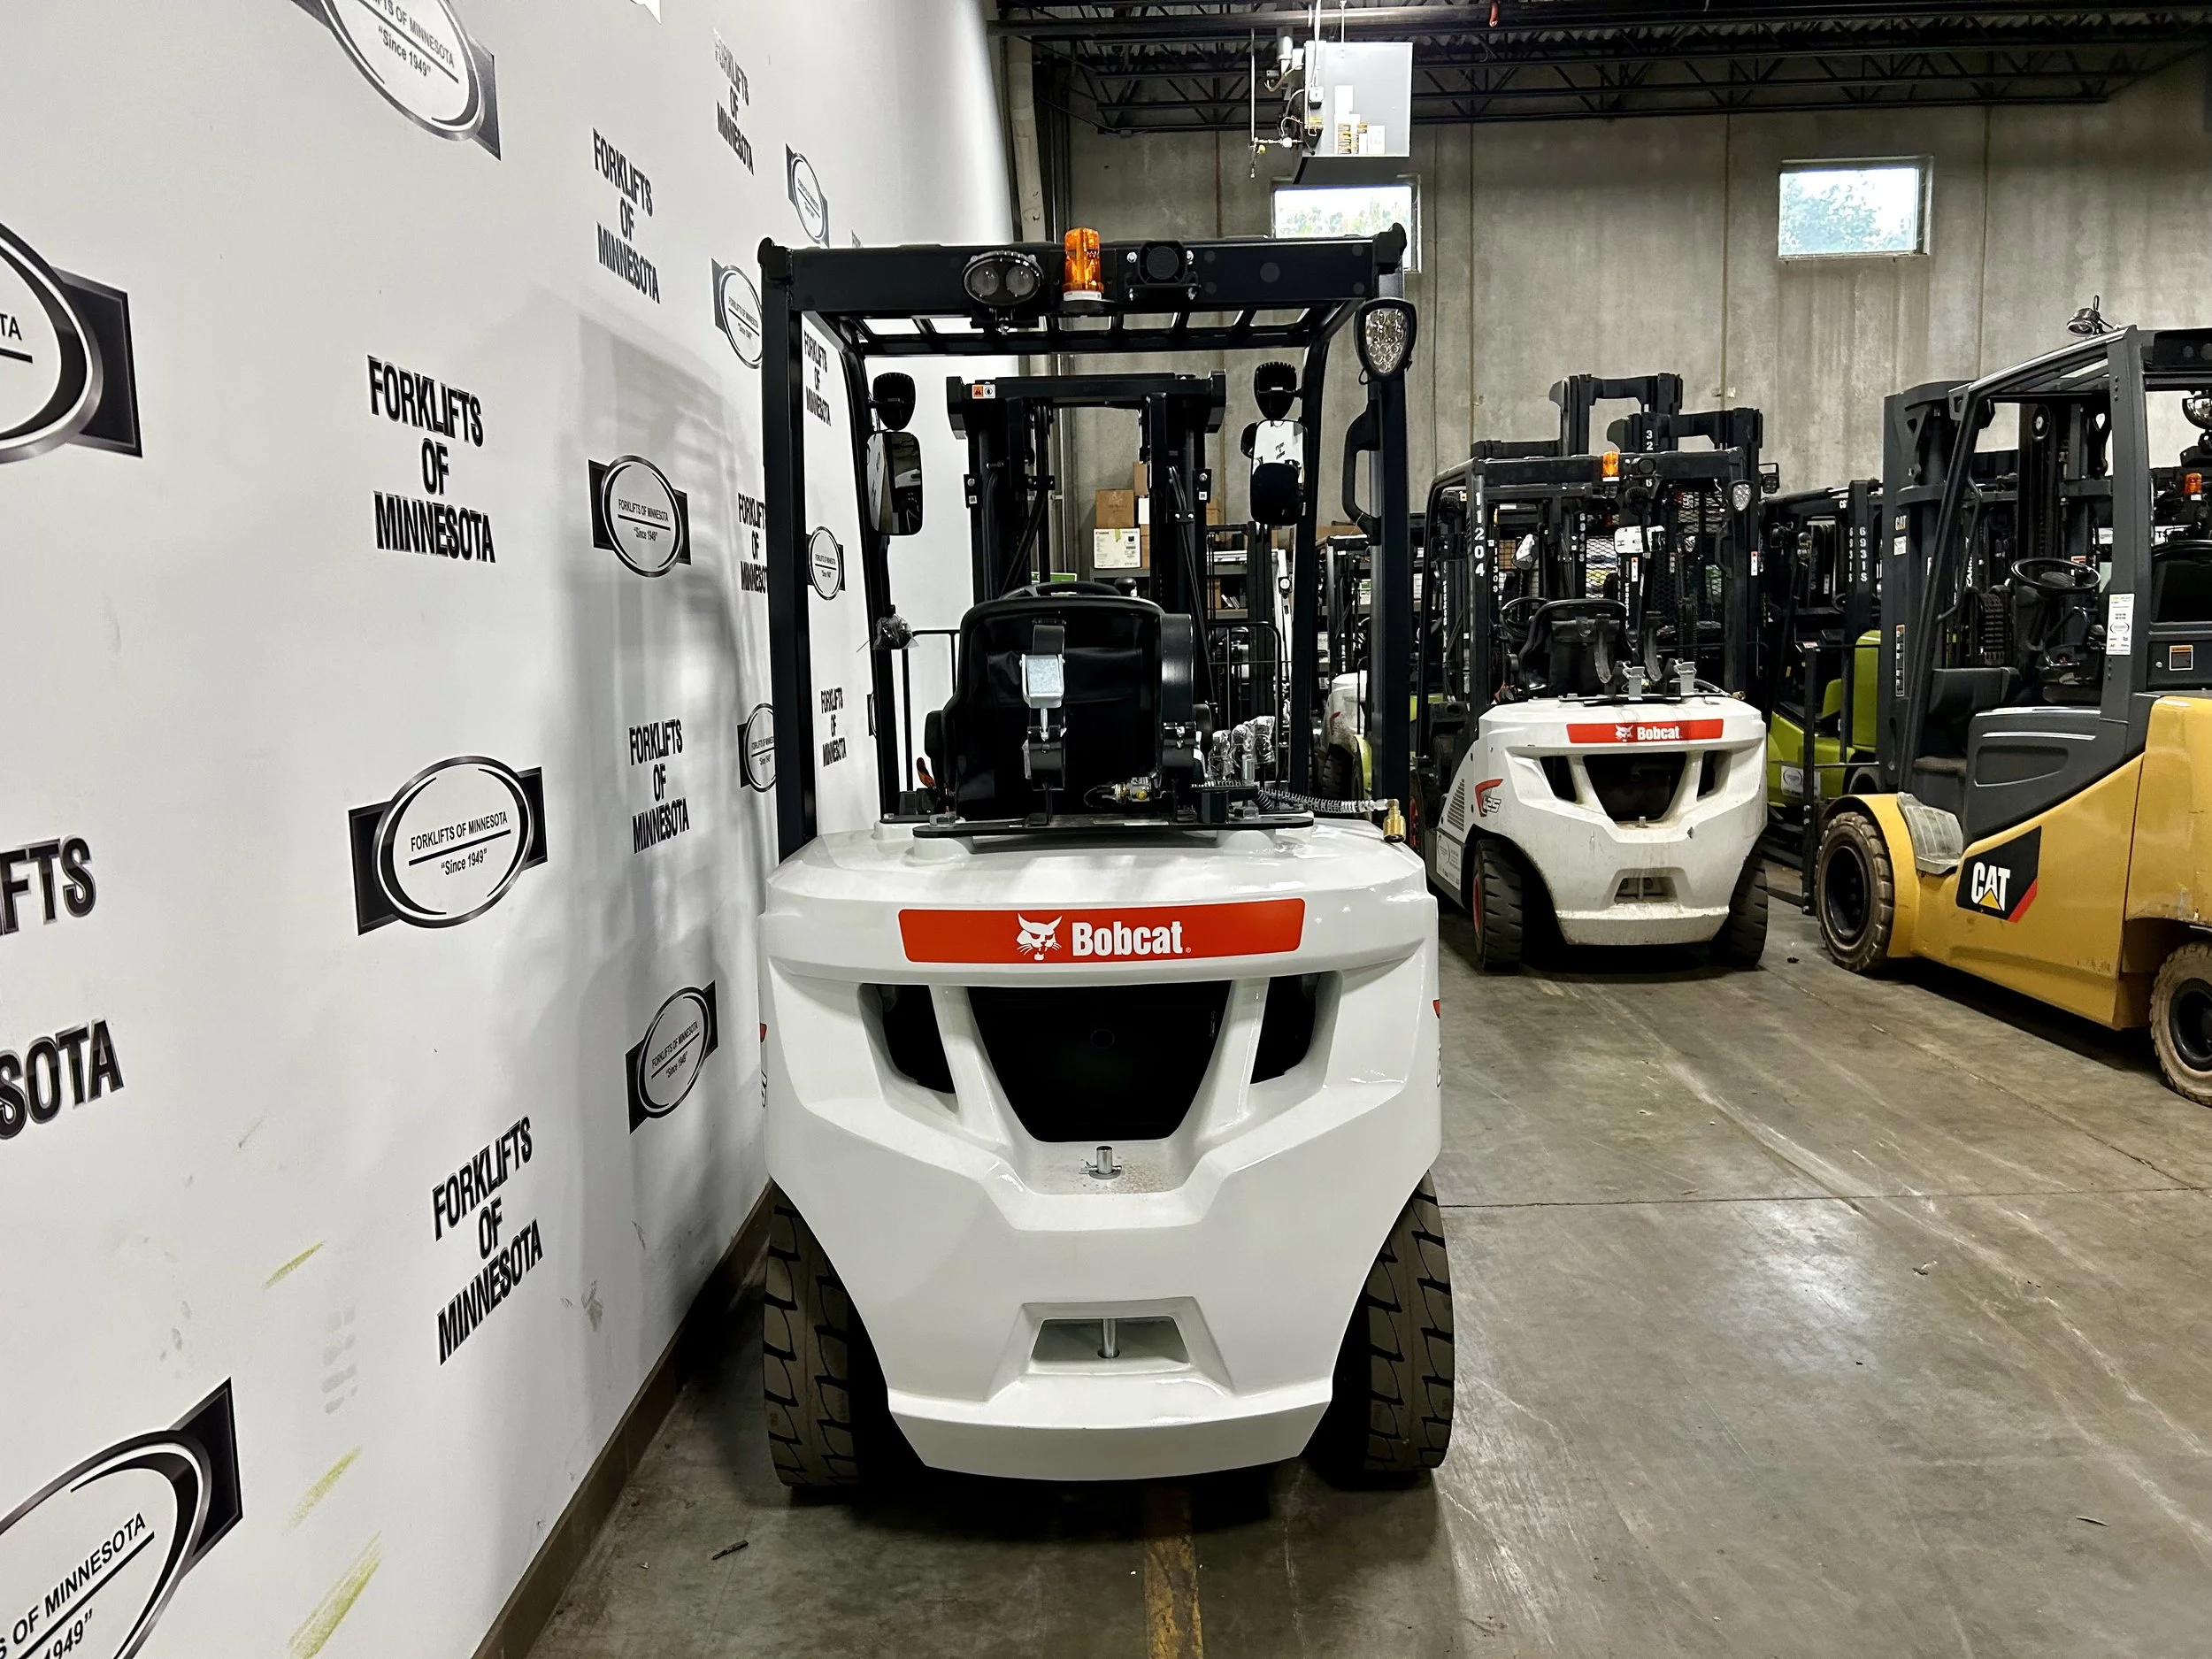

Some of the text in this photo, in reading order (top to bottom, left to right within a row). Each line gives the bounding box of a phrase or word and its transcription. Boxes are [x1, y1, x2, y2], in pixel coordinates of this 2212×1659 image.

[379, 26, 431, 76] “Since 1949”
[396, 6, 407, 26] OF
[410, 17, 455, 68] MINNESOTA
[714, 37, 749, 106] FORKLIFTS
[729, 85, 739, 121] OF
[716, 99, 754, 176] MINNESOTA
[593, 127, 653, 218] FORKLIFTS
[619, 196, 634, 242] OF
[596, 221, 661, 304] MINNESOTA
[803, 329, 827, 373] FORKLIFTS
[367, 355, 484, 448] FORKLIFTS
[814, 366, 820, 392] OF
[805, 385, 832, 426] MINNESOTA
[421, 437, 449, 495] OF
[373, 490, 495, 563] MINNESOTA
[618, 499, 669, 522] FORKLIFTS OF MINNESOTA
[738, 492, 766, 530] FORKLIFT
[751, 531, 759, 560] OF
[629, 718, 683, 765] FORKLIFTS
[1637, 726, 1680, 740] Bobcat
[653, 764, 666, 802] OF
[411, 811, 508, 851] FORKLIFTS OF MINNESOTA
[632, 796, 689, 854] MINNESOTA
[0, 834, 96, 935] FTS
[441, 848, 488, 876] “Since 1949”
[1971, 862, 2011, 911] CAT
[1071, 920, 1183, 956] Bobcat
[652, 1043, 673, 1069] FORKLIFTS
[432, 1116, 532, 1241] FORKLIFTS
[479, 1194, 503, 1259] OF
[436, 1218, 544, 1366] MINNESOTA
[12, 1512, 146, 1645] OF MINNESOTA
